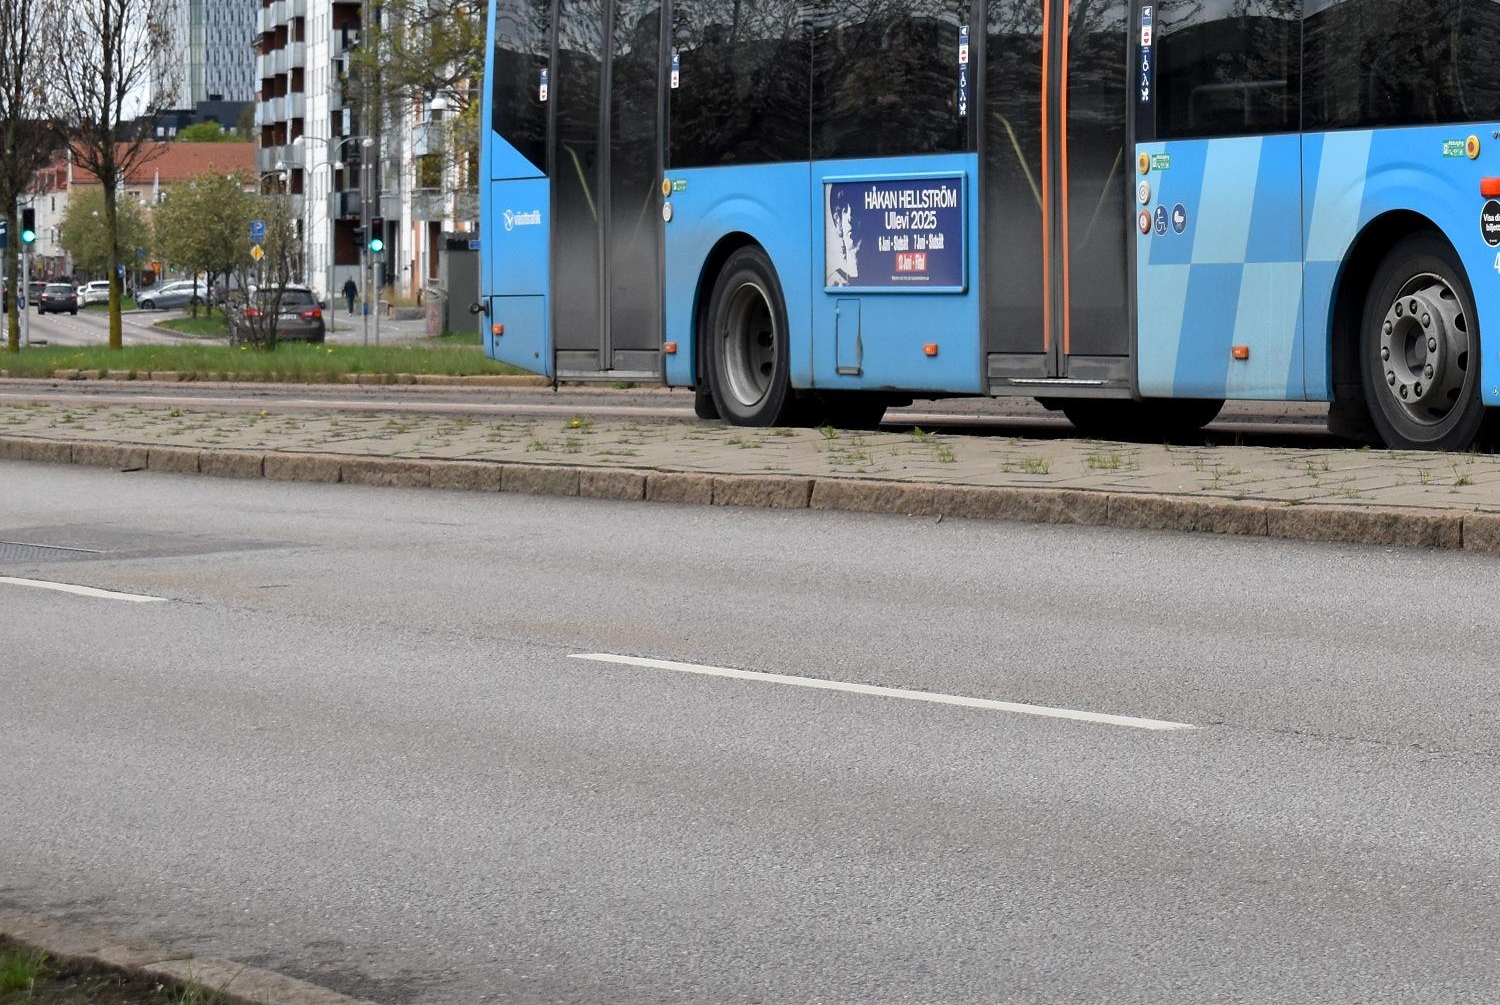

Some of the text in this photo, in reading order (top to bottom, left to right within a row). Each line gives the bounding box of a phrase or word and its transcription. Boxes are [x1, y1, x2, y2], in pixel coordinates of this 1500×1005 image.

[864, 185, 957, 210] HÅKAN HELLSTRÖM
[885, 210, 937, 230] Ullevi 2025
[1483, 213, 1494, 222] Visa
